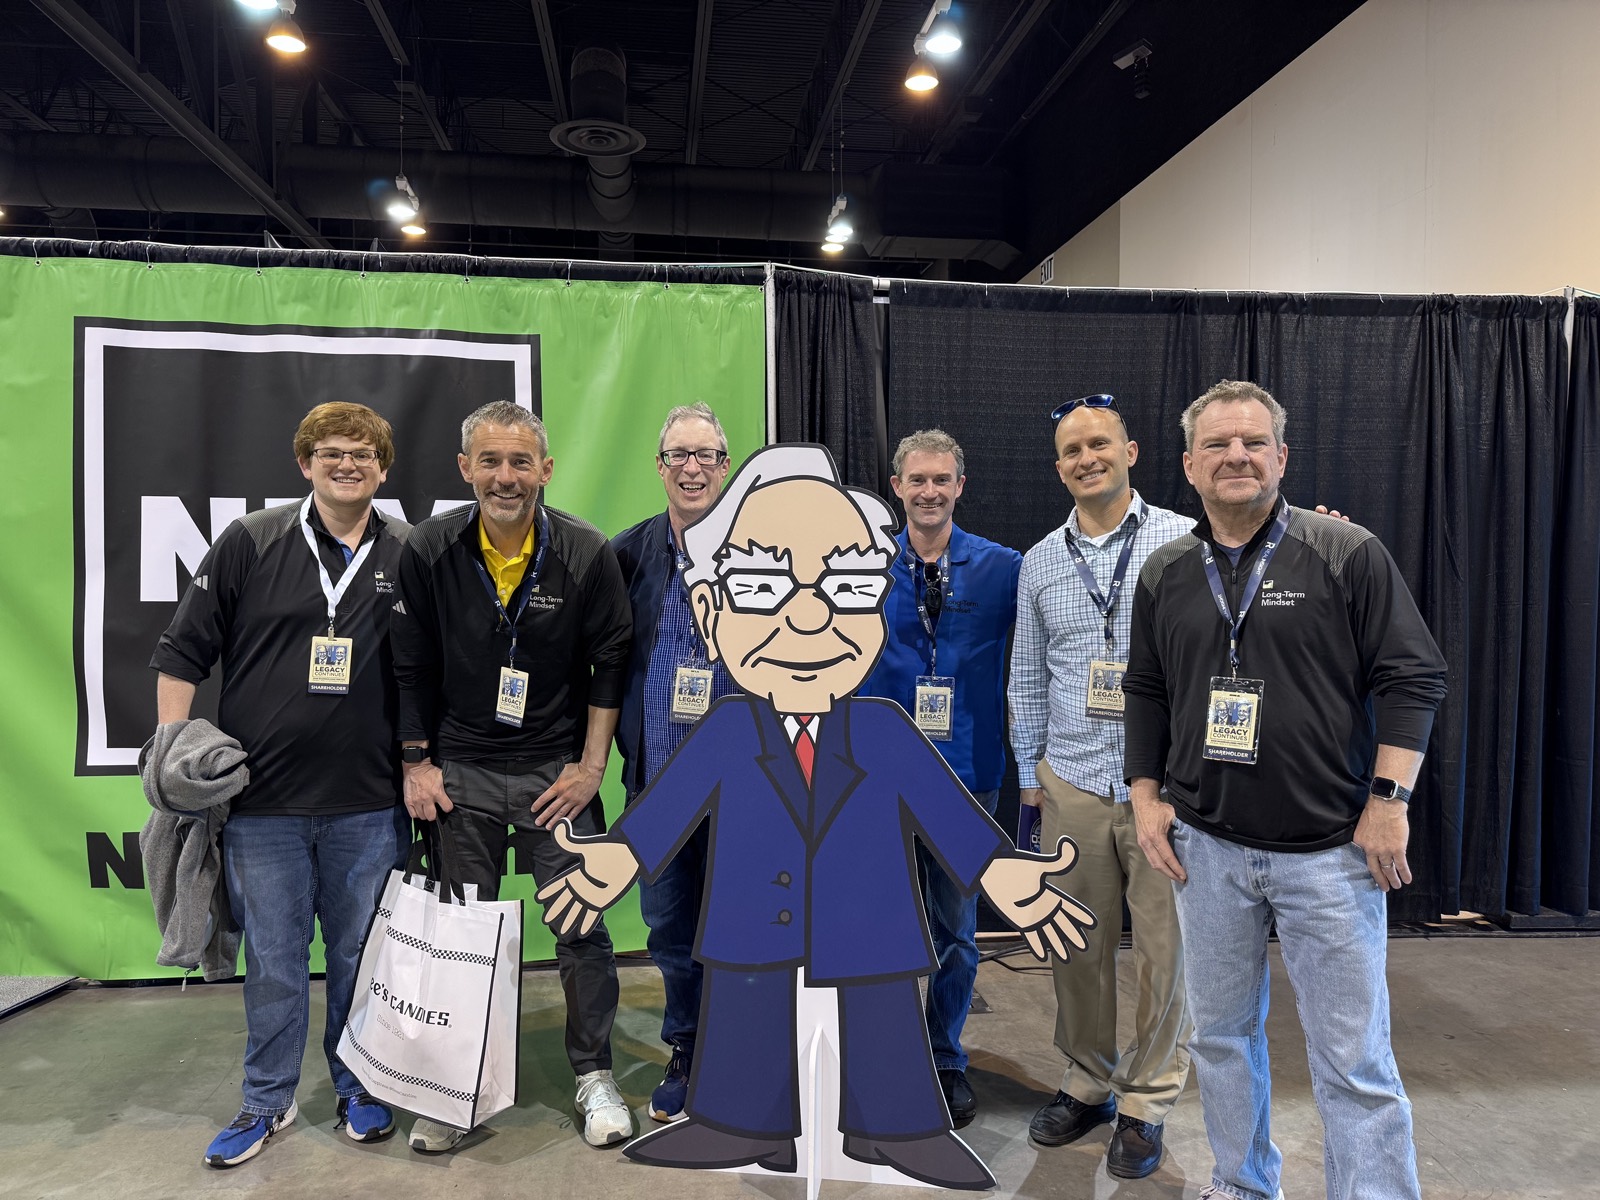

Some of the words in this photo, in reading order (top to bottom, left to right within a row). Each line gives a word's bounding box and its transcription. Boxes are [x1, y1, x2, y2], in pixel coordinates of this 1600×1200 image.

[1041, 257, 1053, 284] EXIT
[530, 595, 563, 603] Long-Term
[1262, 591, 1305, 599] Long-Term
[1261, 599, 1295, 607] Mindset
[1092, 690, 1122, 699] LEGACY
[501, 696, 522, 706] LEGACY
[678, 696, 705, 704] LEGACY
[1089, 709, 1124, 717] SHAREHOLDER
[1213, 726, 1249, 736] LEGACY
[1212, 733, 1248, 741] CONTINUES
[1208, 748, 1249, 758] SHAREHOLDER
